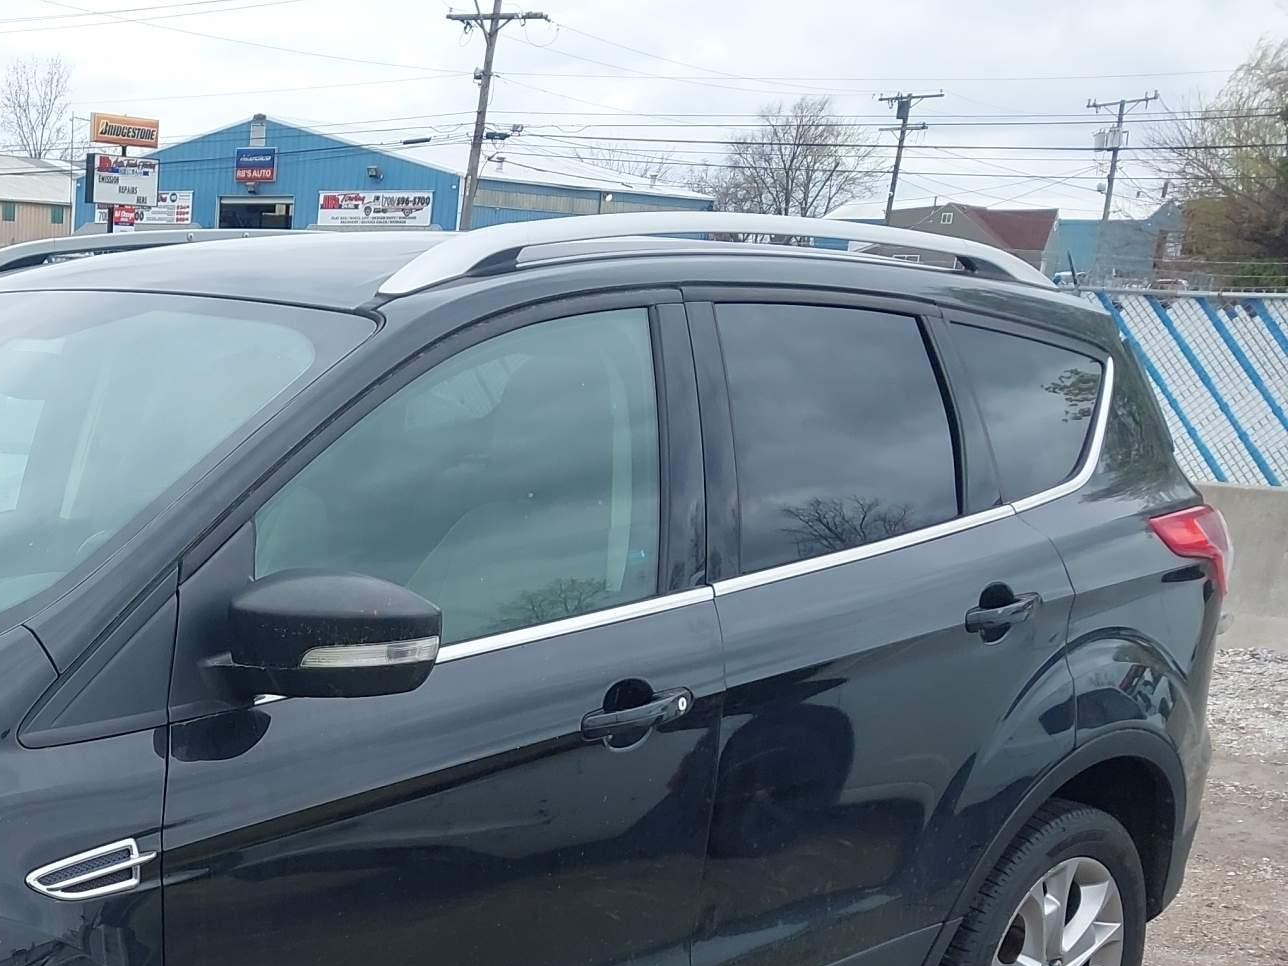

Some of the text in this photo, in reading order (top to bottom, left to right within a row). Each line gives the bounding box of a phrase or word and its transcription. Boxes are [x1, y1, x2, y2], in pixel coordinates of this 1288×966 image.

[99, 120, 156, 140] BRIDGESTONE
[252, 169, 272, 178] AUTO
[98, 175, 120, 184] EMISSION
[118, 185, 138, 195] REPAIRS
